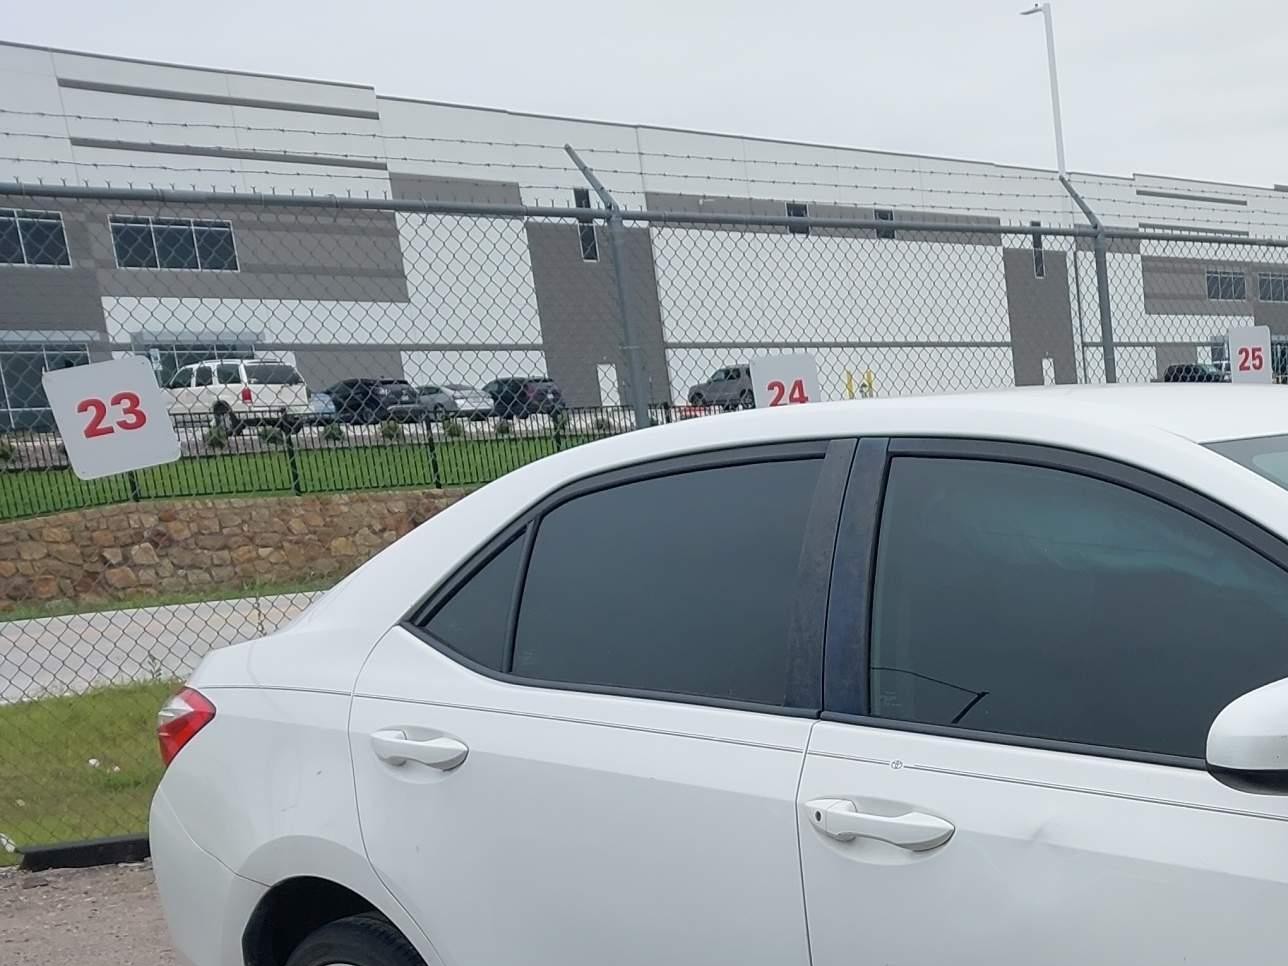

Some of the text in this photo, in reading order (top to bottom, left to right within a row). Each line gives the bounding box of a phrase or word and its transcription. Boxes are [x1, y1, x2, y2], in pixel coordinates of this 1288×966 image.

[1238, 347, 1264, 371] 25
[767, 379, 809, 407] 24
[77, 391, 147, 439] 23
